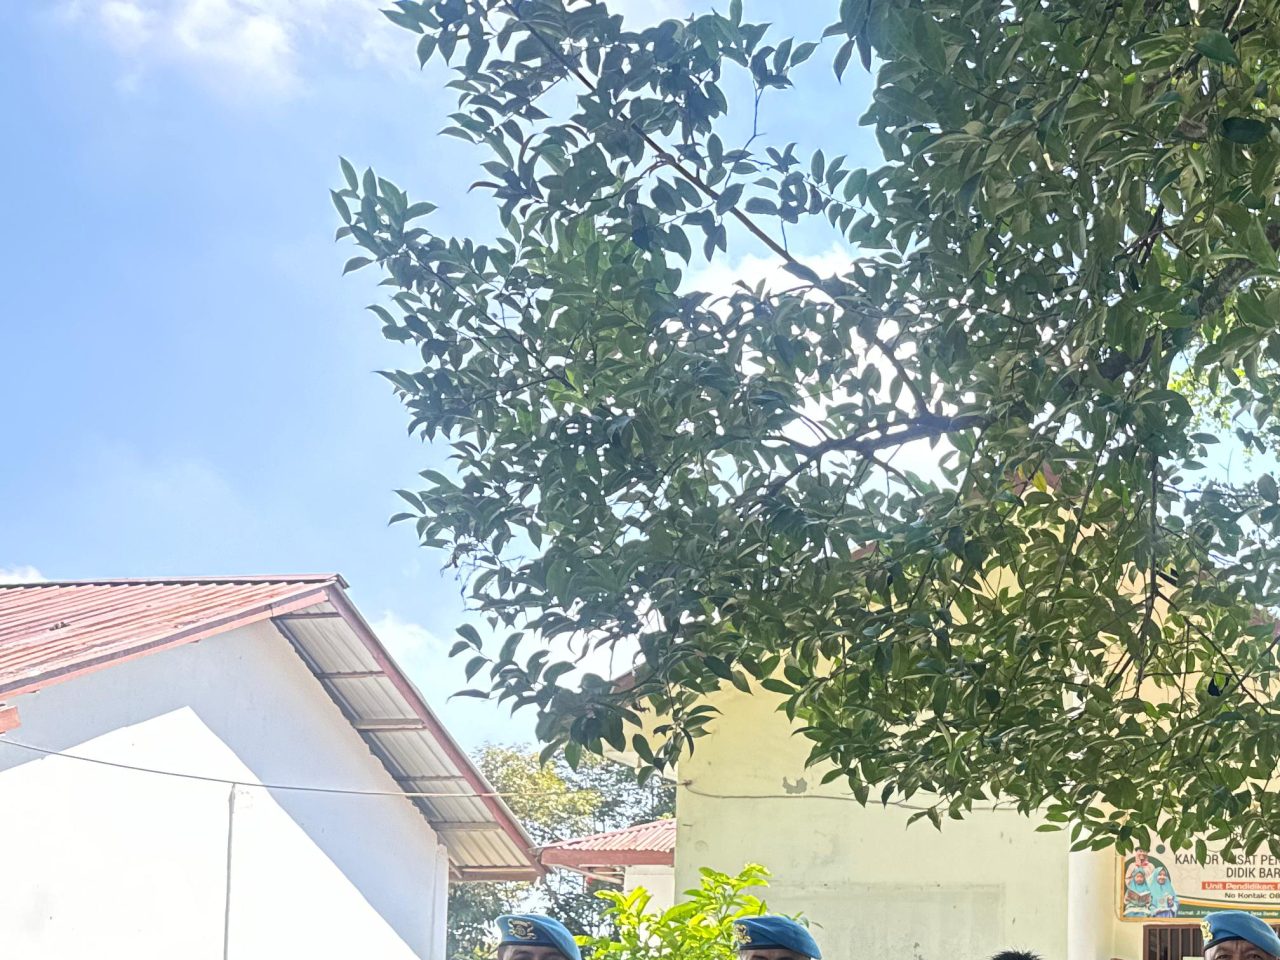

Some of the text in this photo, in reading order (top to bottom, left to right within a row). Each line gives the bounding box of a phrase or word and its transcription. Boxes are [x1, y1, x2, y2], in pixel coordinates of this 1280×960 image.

[1175, 854, 1219, 865] KANOR
[1223, 855, 1258, 865] SAT
[1226, 867, 1256, 878] DIDIK
